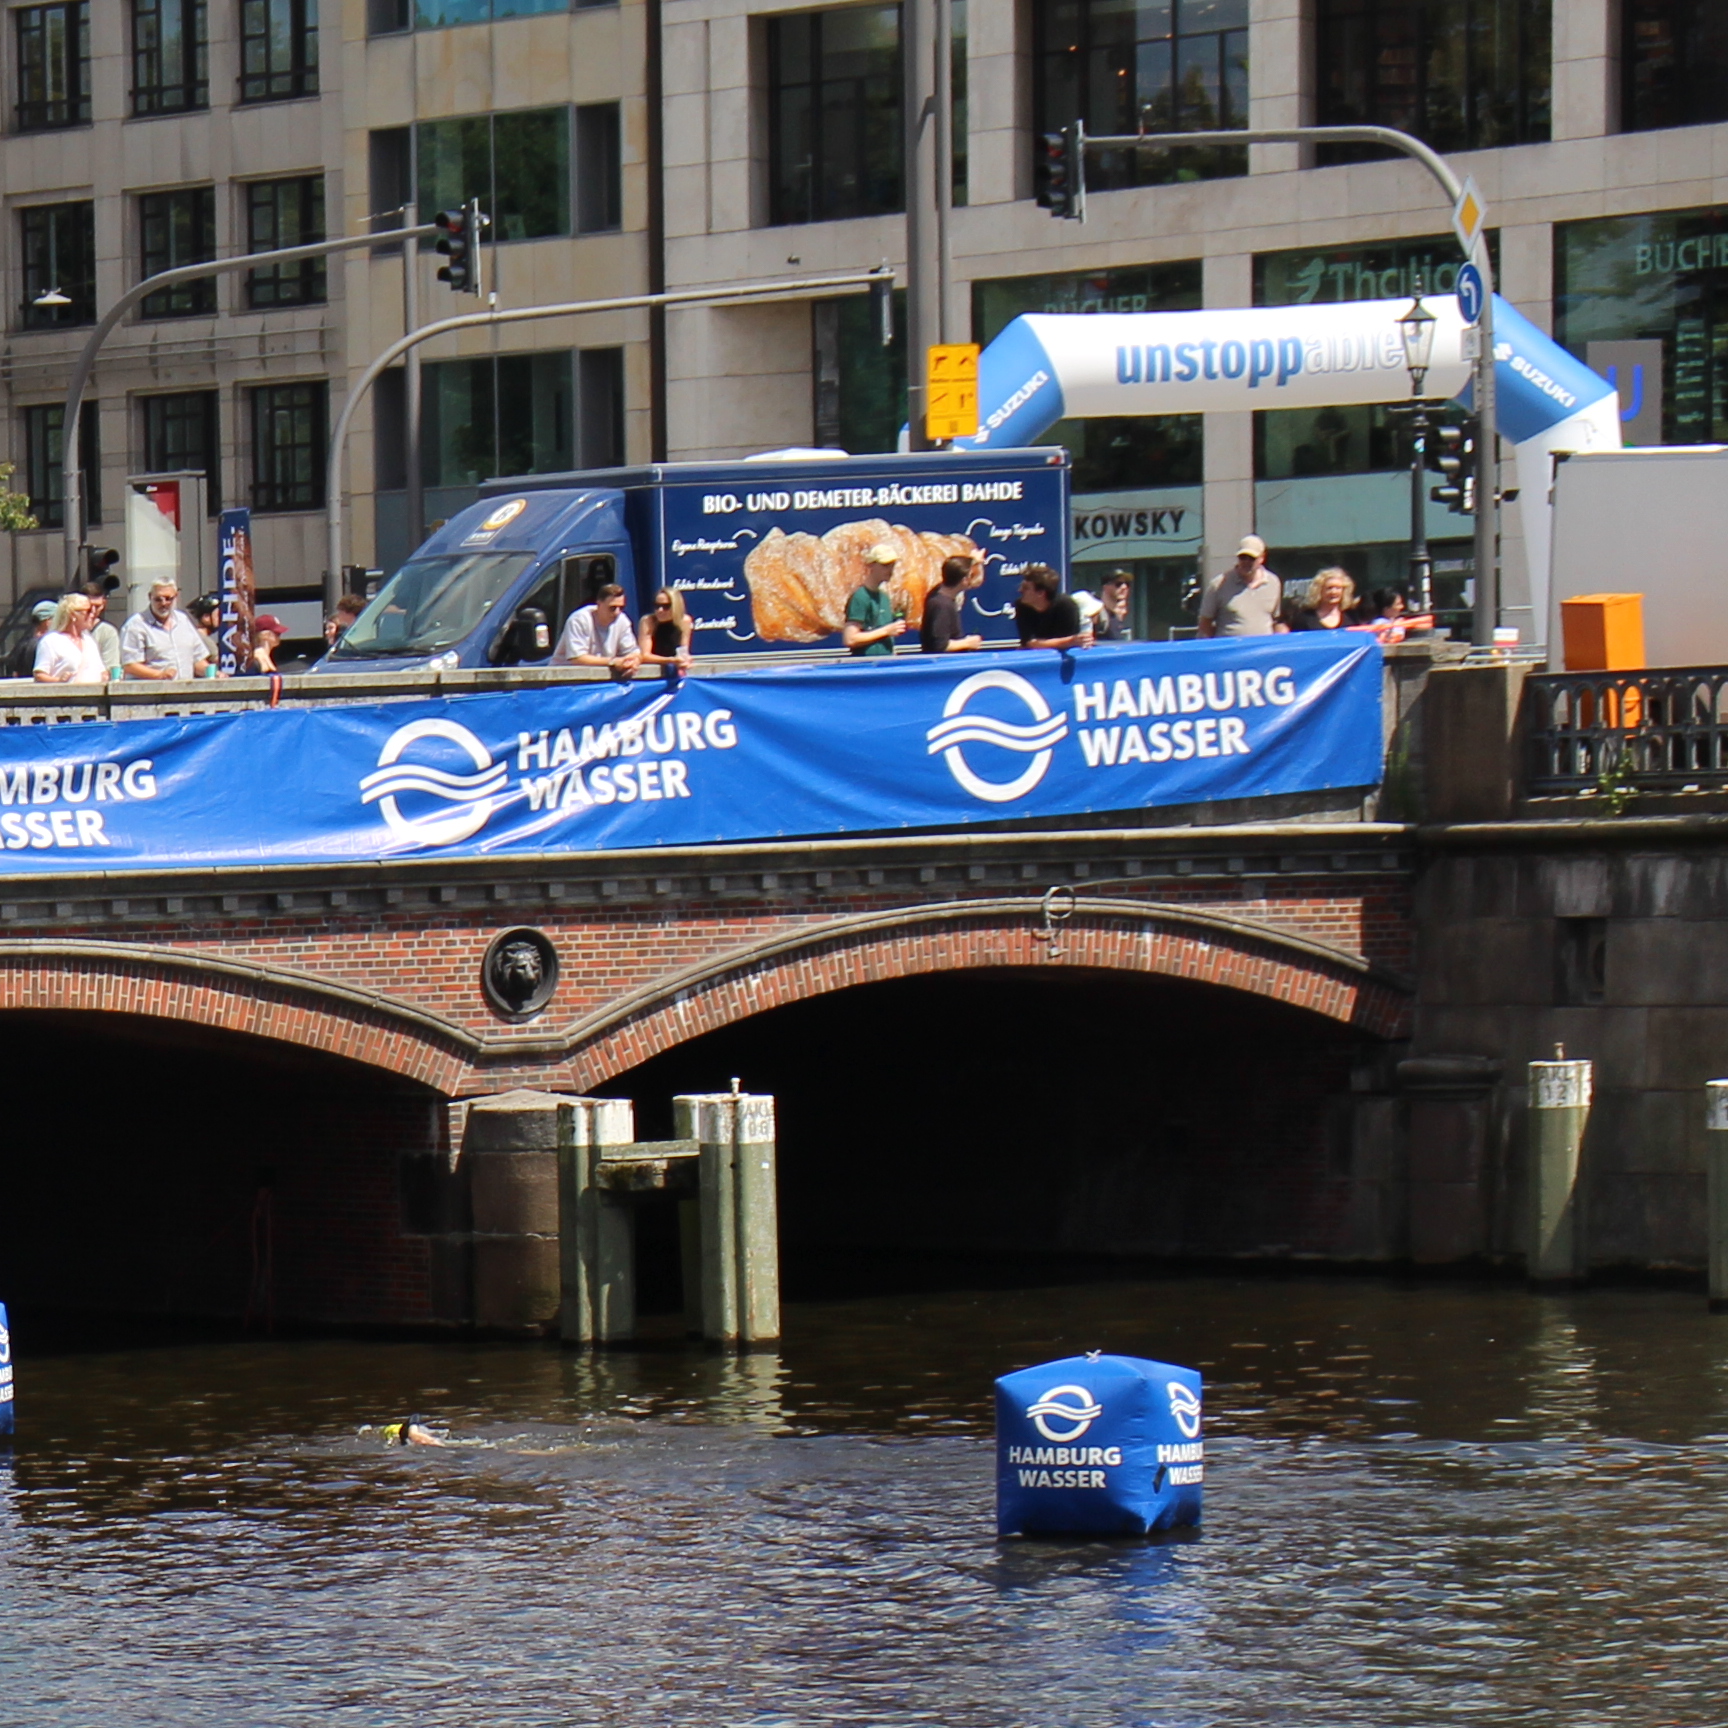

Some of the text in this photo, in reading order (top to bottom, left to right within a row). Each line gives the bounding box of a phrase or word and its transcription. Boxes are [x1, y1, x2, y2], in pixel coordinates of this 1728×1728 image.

[1636, 234, 1728, 275] BÜCHE
[986, 370, 1049, 430] SUZUKI
[1509, 356, 1577, 409] SUZUKI
[703, 481, 1023, 514] BIO- UND DEMETER-BÄCKEREI BAHDE
[1074, 509, 1186, 540] KOWSKY
[1074, 667, 1297, 722] HAMBURG
[518, 709, 738, 772] HAMBURG
[1078, 716, 1251, 768] WASSER
[522, 760, 692, 812] WASSER
[1009, 1445, 1123, 1466] HAMBURG
[1018, 1469, 1107, 1488] WASSER
